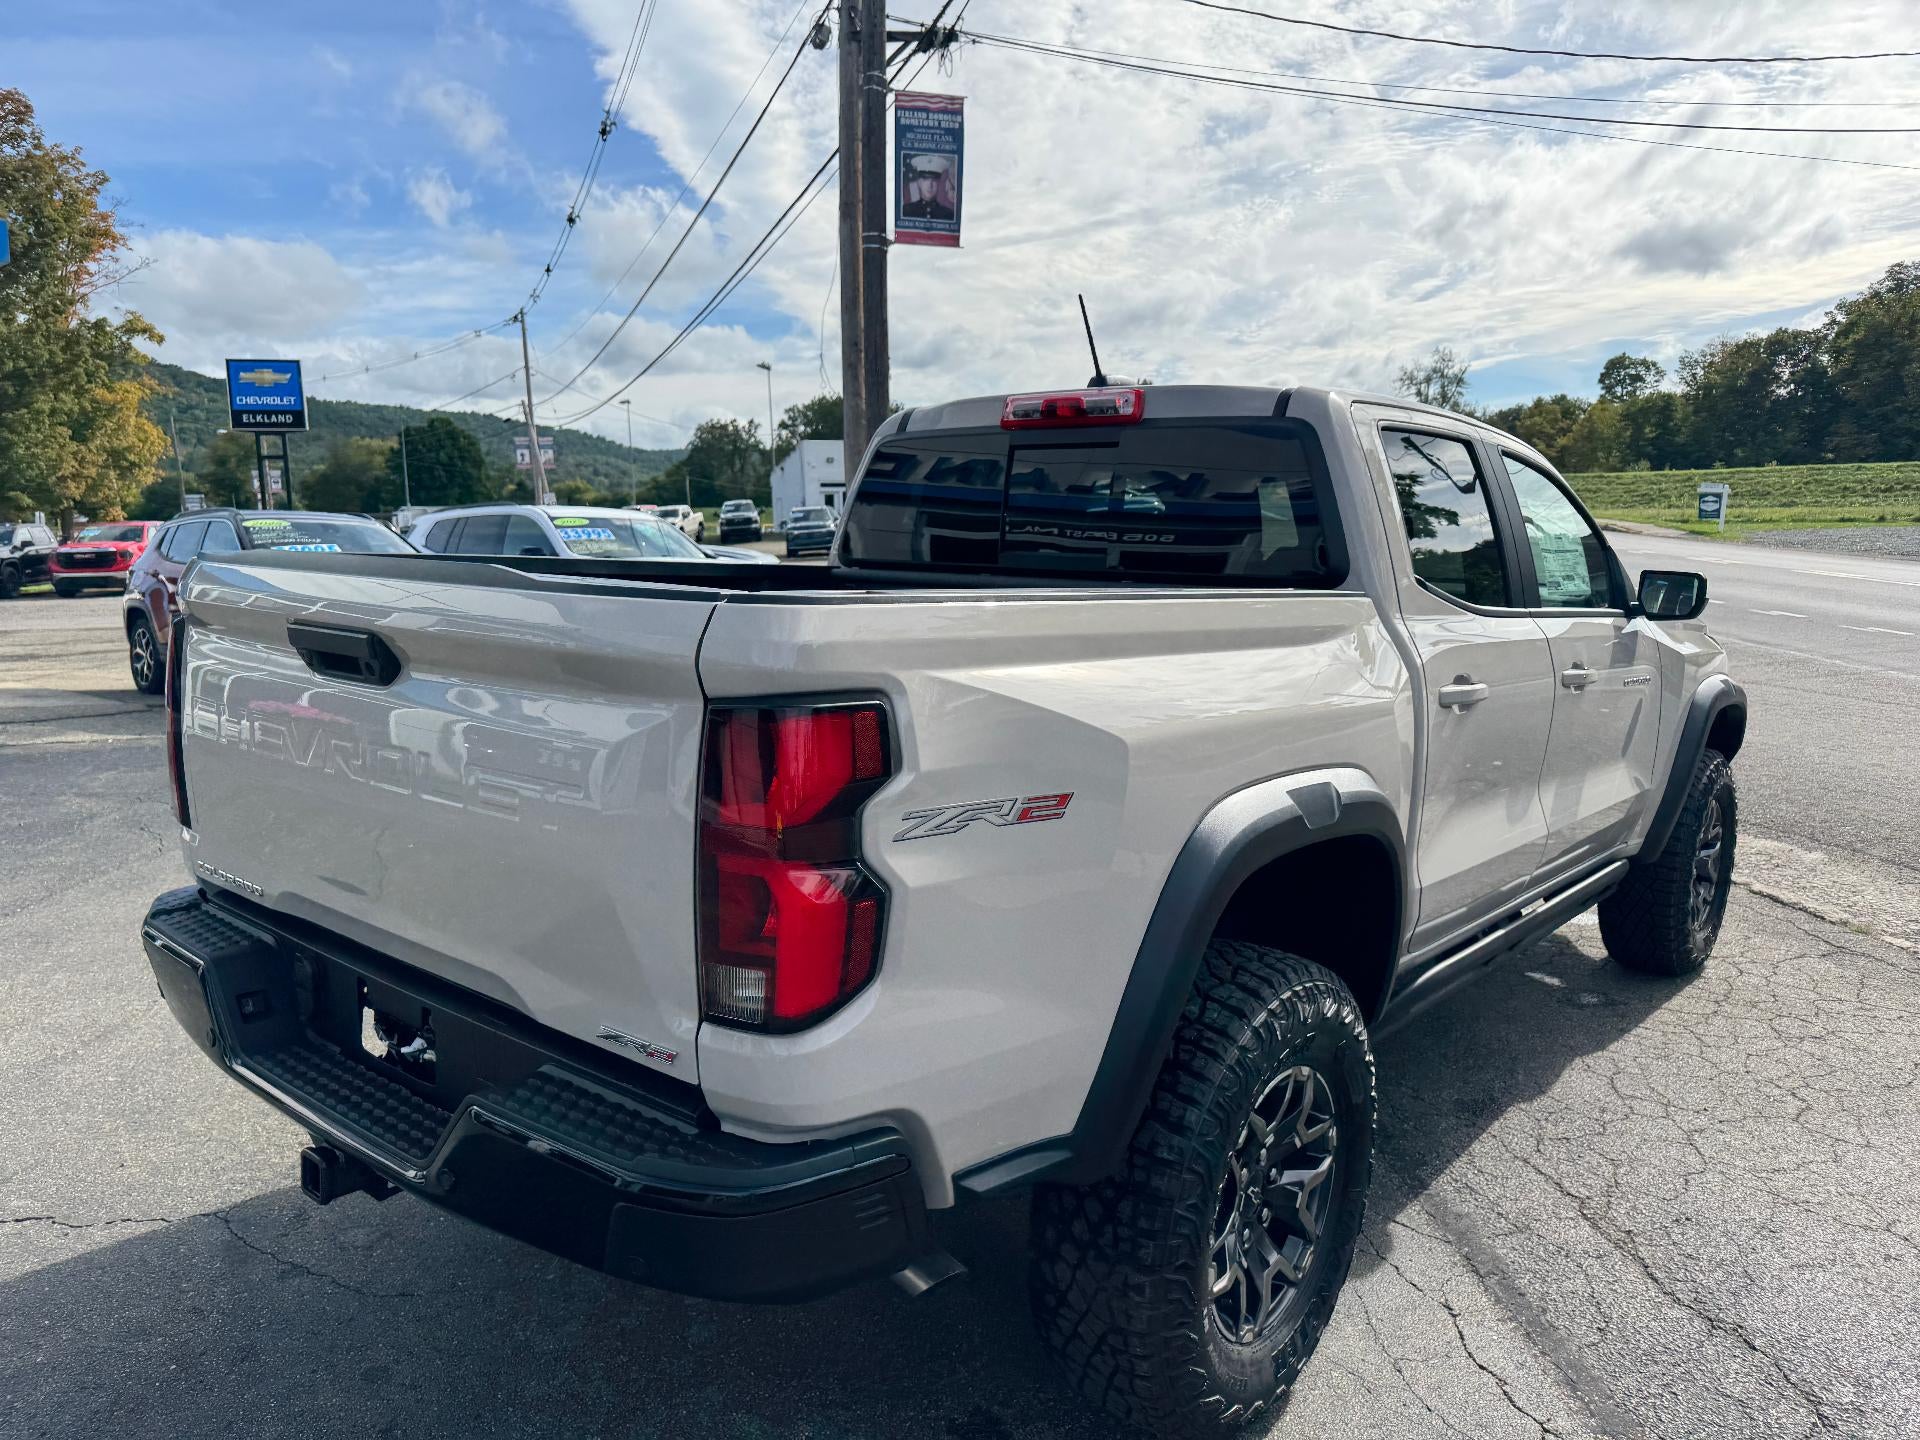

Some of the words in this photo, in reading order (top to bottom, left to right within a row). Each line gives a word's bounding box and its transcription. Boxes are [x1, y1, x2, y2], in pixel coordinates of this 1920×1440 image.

[236, 396, 296, 405] CHEVROLET
[242, 414, 293, 424] ELKLAND
[892, 792, 1074, 842] ZR2
[197, 860, 264, 896] COLORADO
[596, 1025, 679, 1065] ZR2
